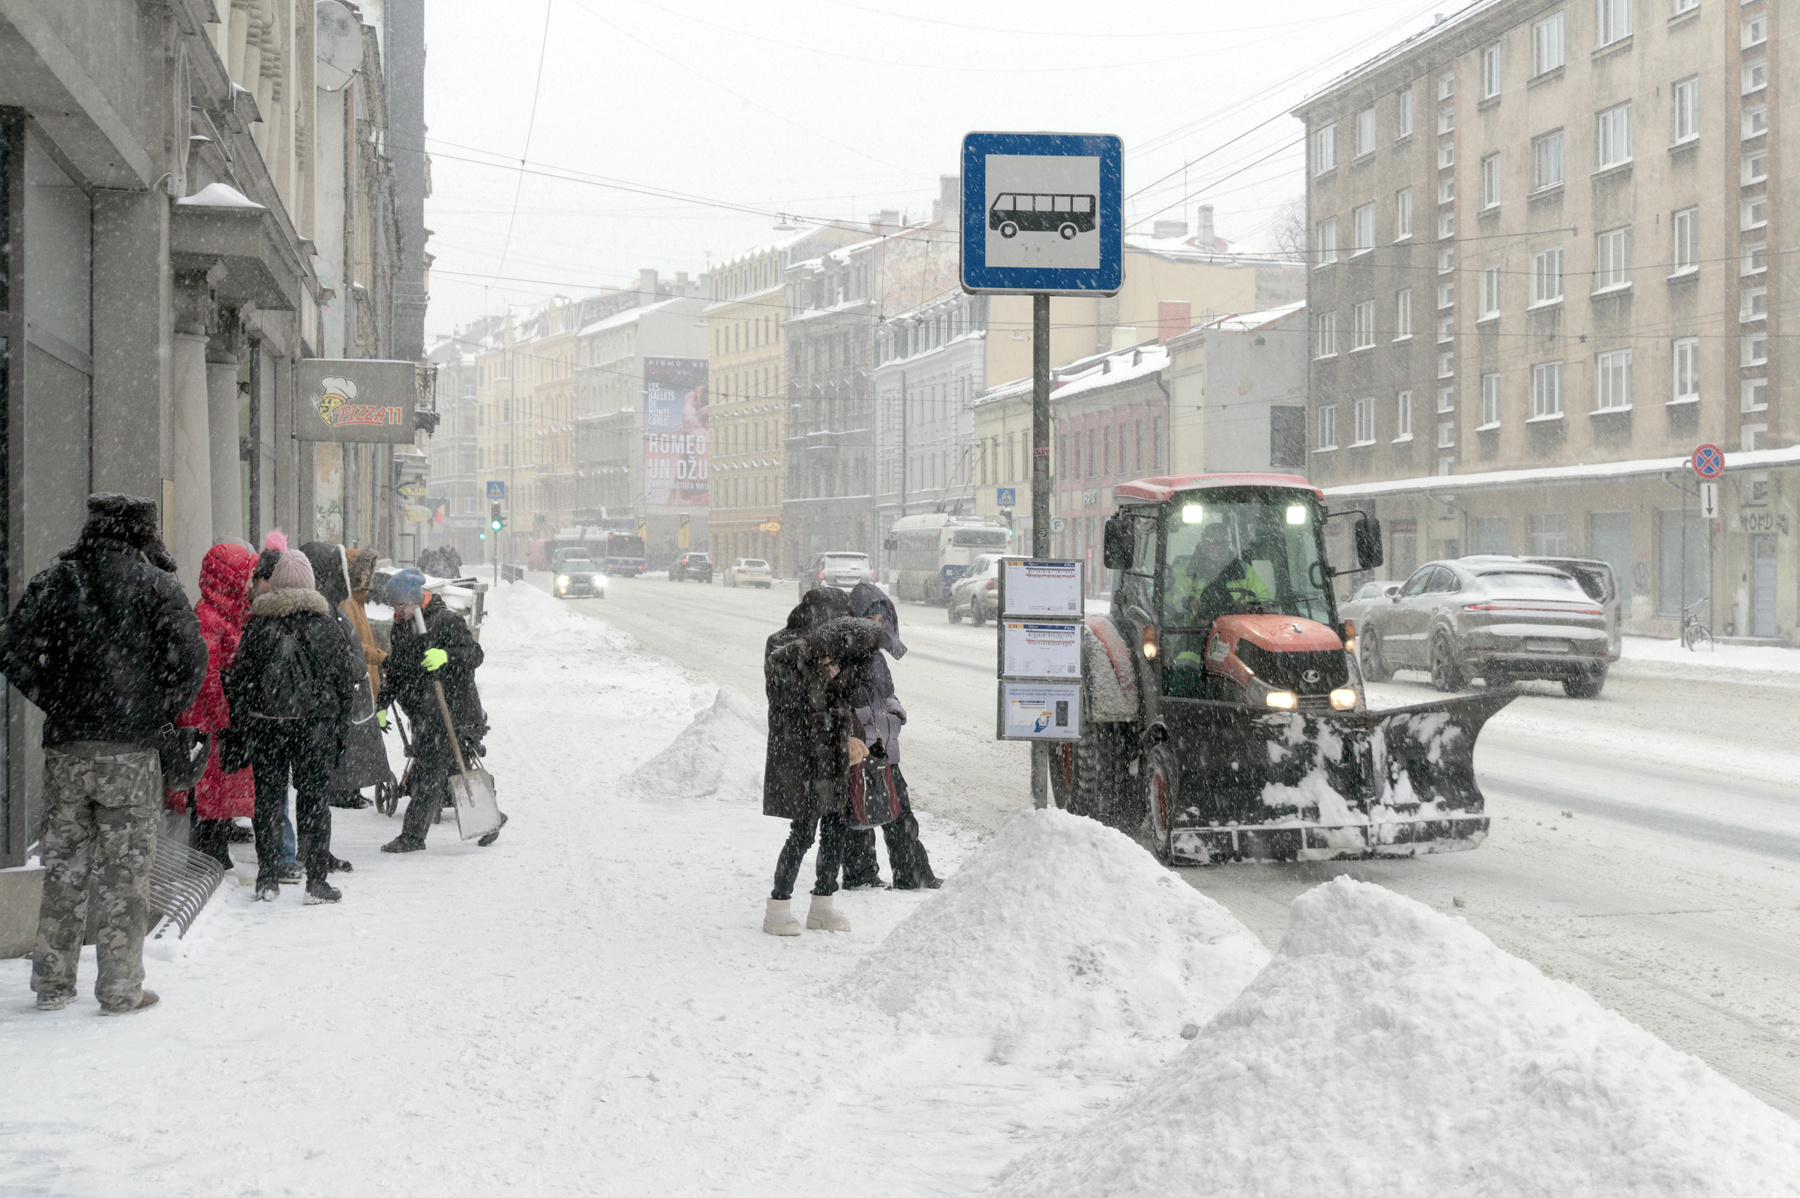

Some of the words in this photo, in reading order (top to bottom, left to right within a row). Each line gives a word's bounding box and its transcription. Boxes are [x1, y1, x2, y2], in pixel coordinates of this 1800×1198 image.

[649, 383, 660, 391] LES
[649, 391, 675, 400] BALLETS
[649, 400, 657, 408] DE
[648, 408, 670, 417] MONTE
[648, 417, 669, 426] CARLO
[648, 433, 706, 455] ROMEO
[649, 458, 670, 479] UN
[676, 456, 708, 480] DŽU
[639, 518, 645, 526] P
[681, 516, 689, 525] P
[1054, 521, 1061, 530] F
